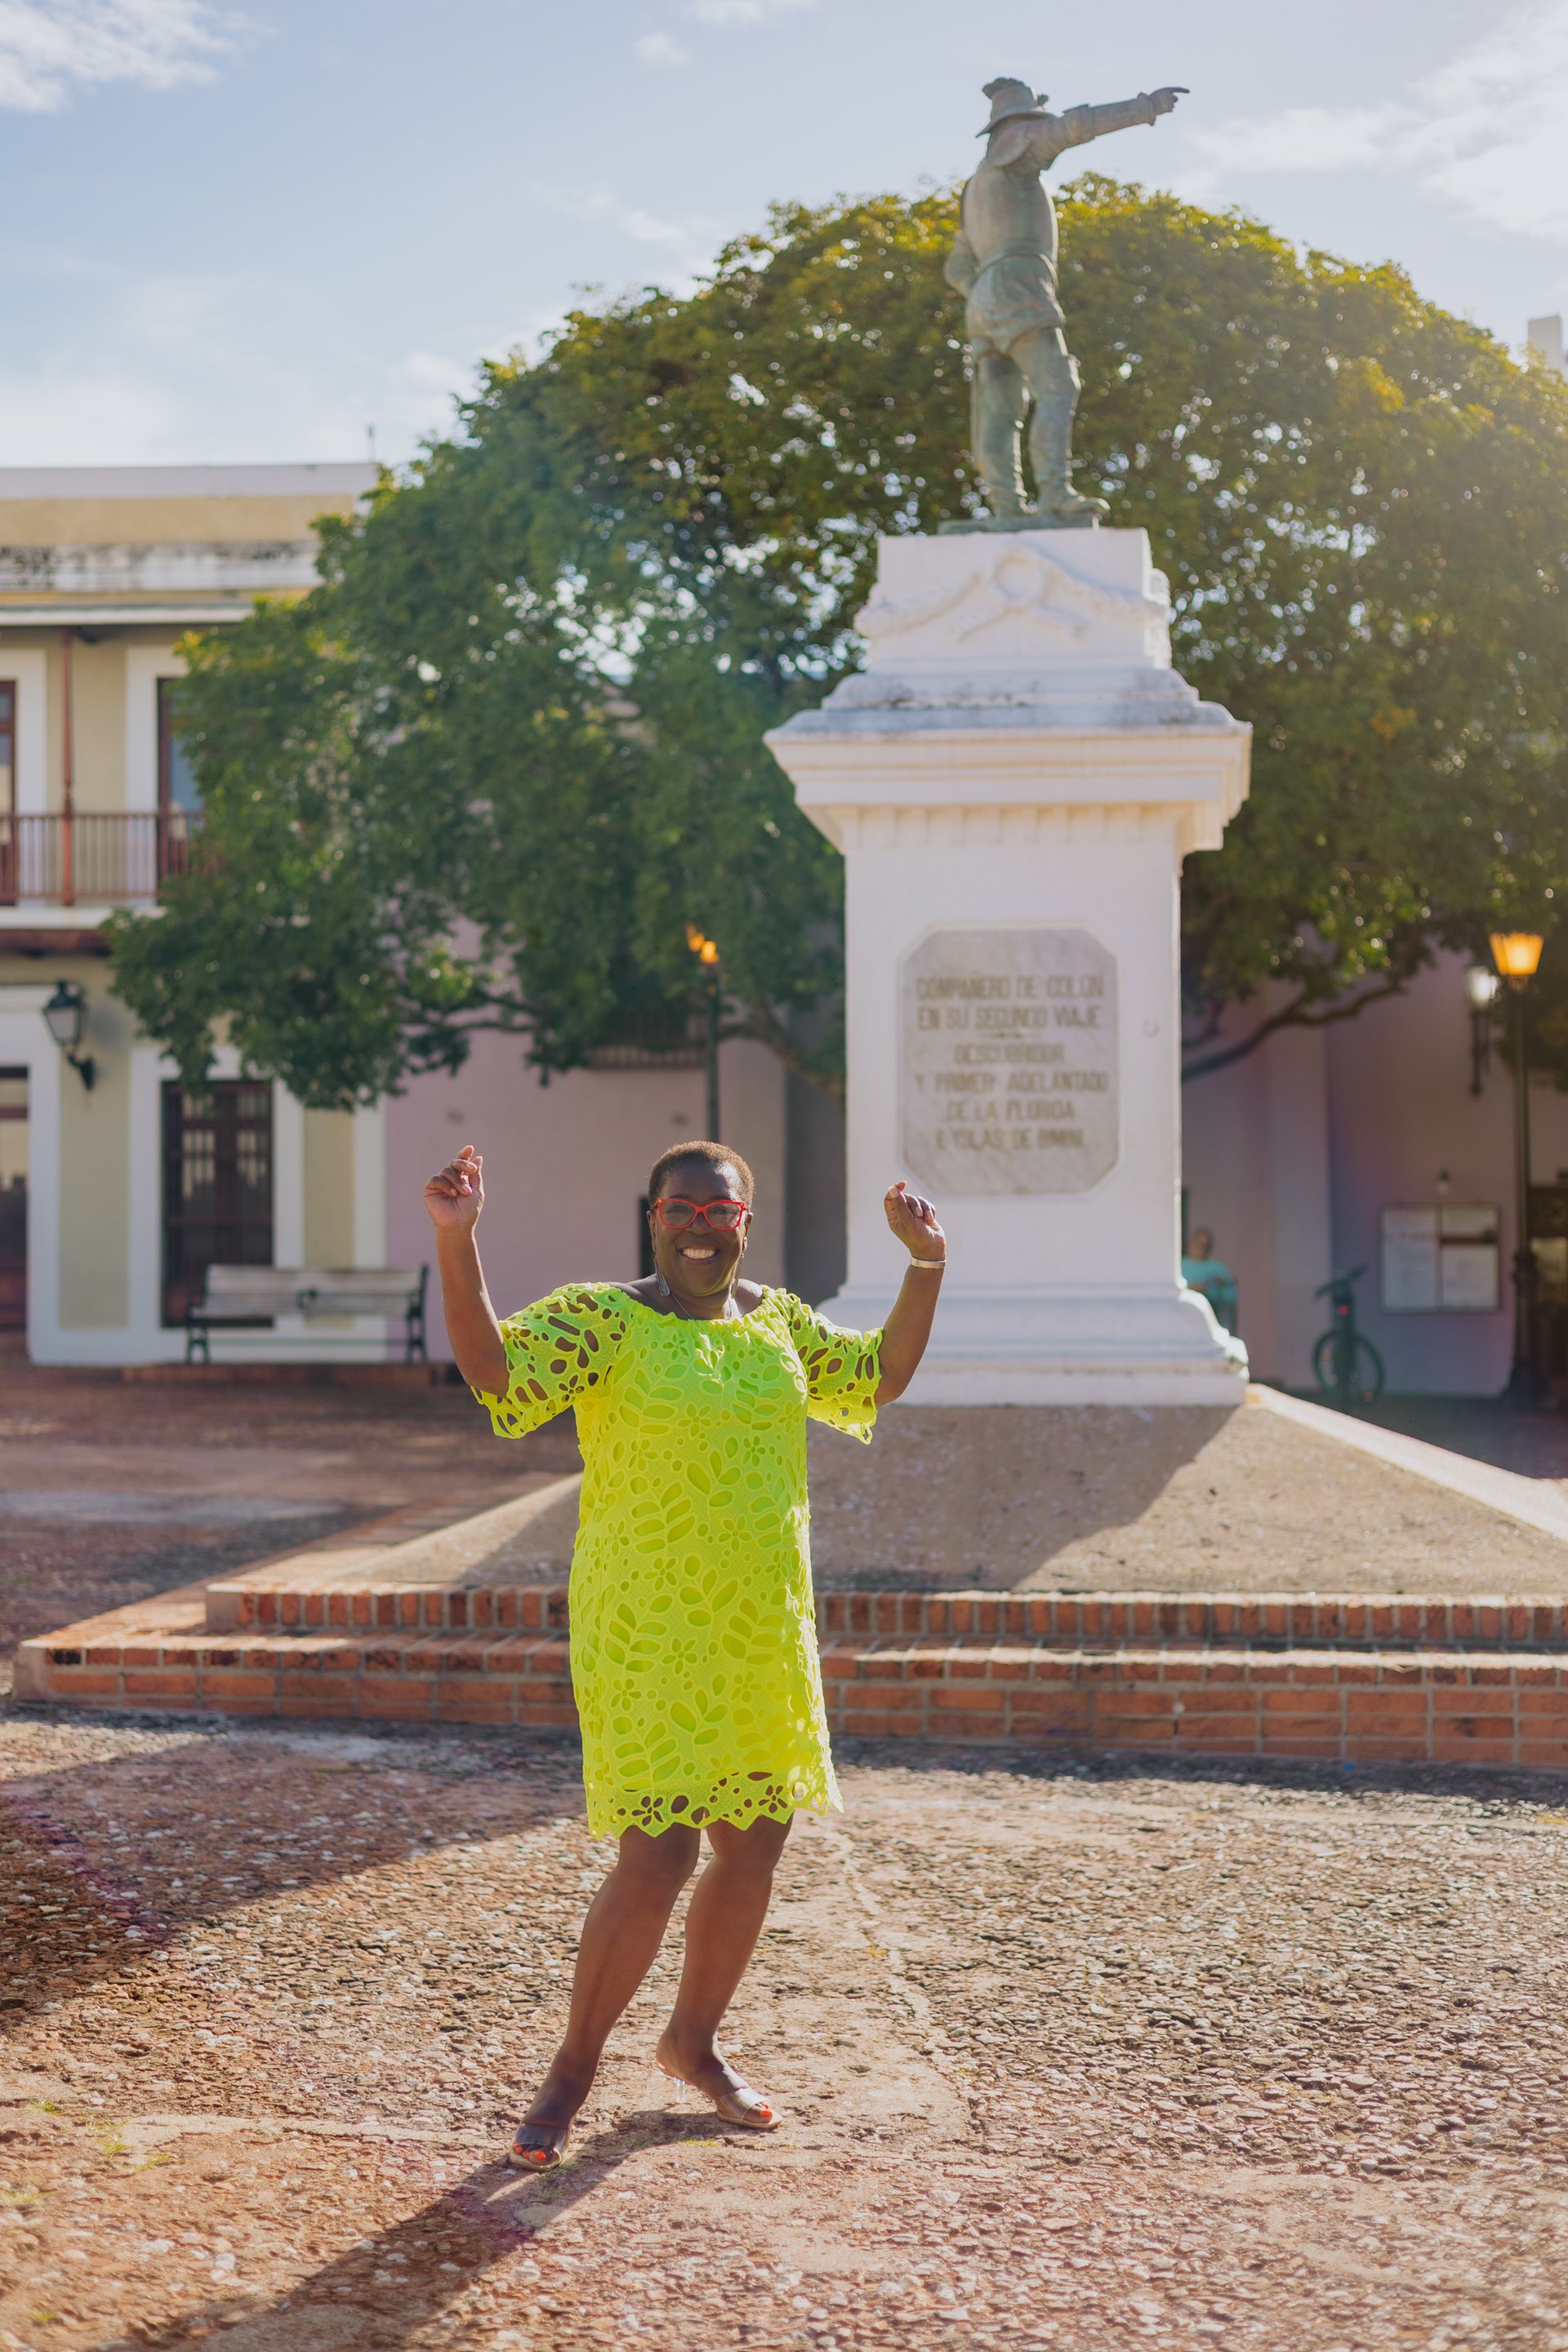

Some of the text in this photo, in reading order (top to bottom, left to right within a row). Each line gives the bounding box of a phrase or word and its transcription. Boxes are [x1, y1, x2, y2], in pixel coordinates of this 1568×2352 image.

[1016, 975, 1039, 999] DE
[917, 1004, 1101, 1030] EN SU SEGUNDO VIAJE
[954, 1043, 1065, 1065] DESCUBRIDOR
[915, 1071, 1109, 1093] Y PRIMER ADELANTADO
[947, 1099, 1076, 1121] DE LA FLORIDA
[1011, 1128, 1031, 1150] DE
